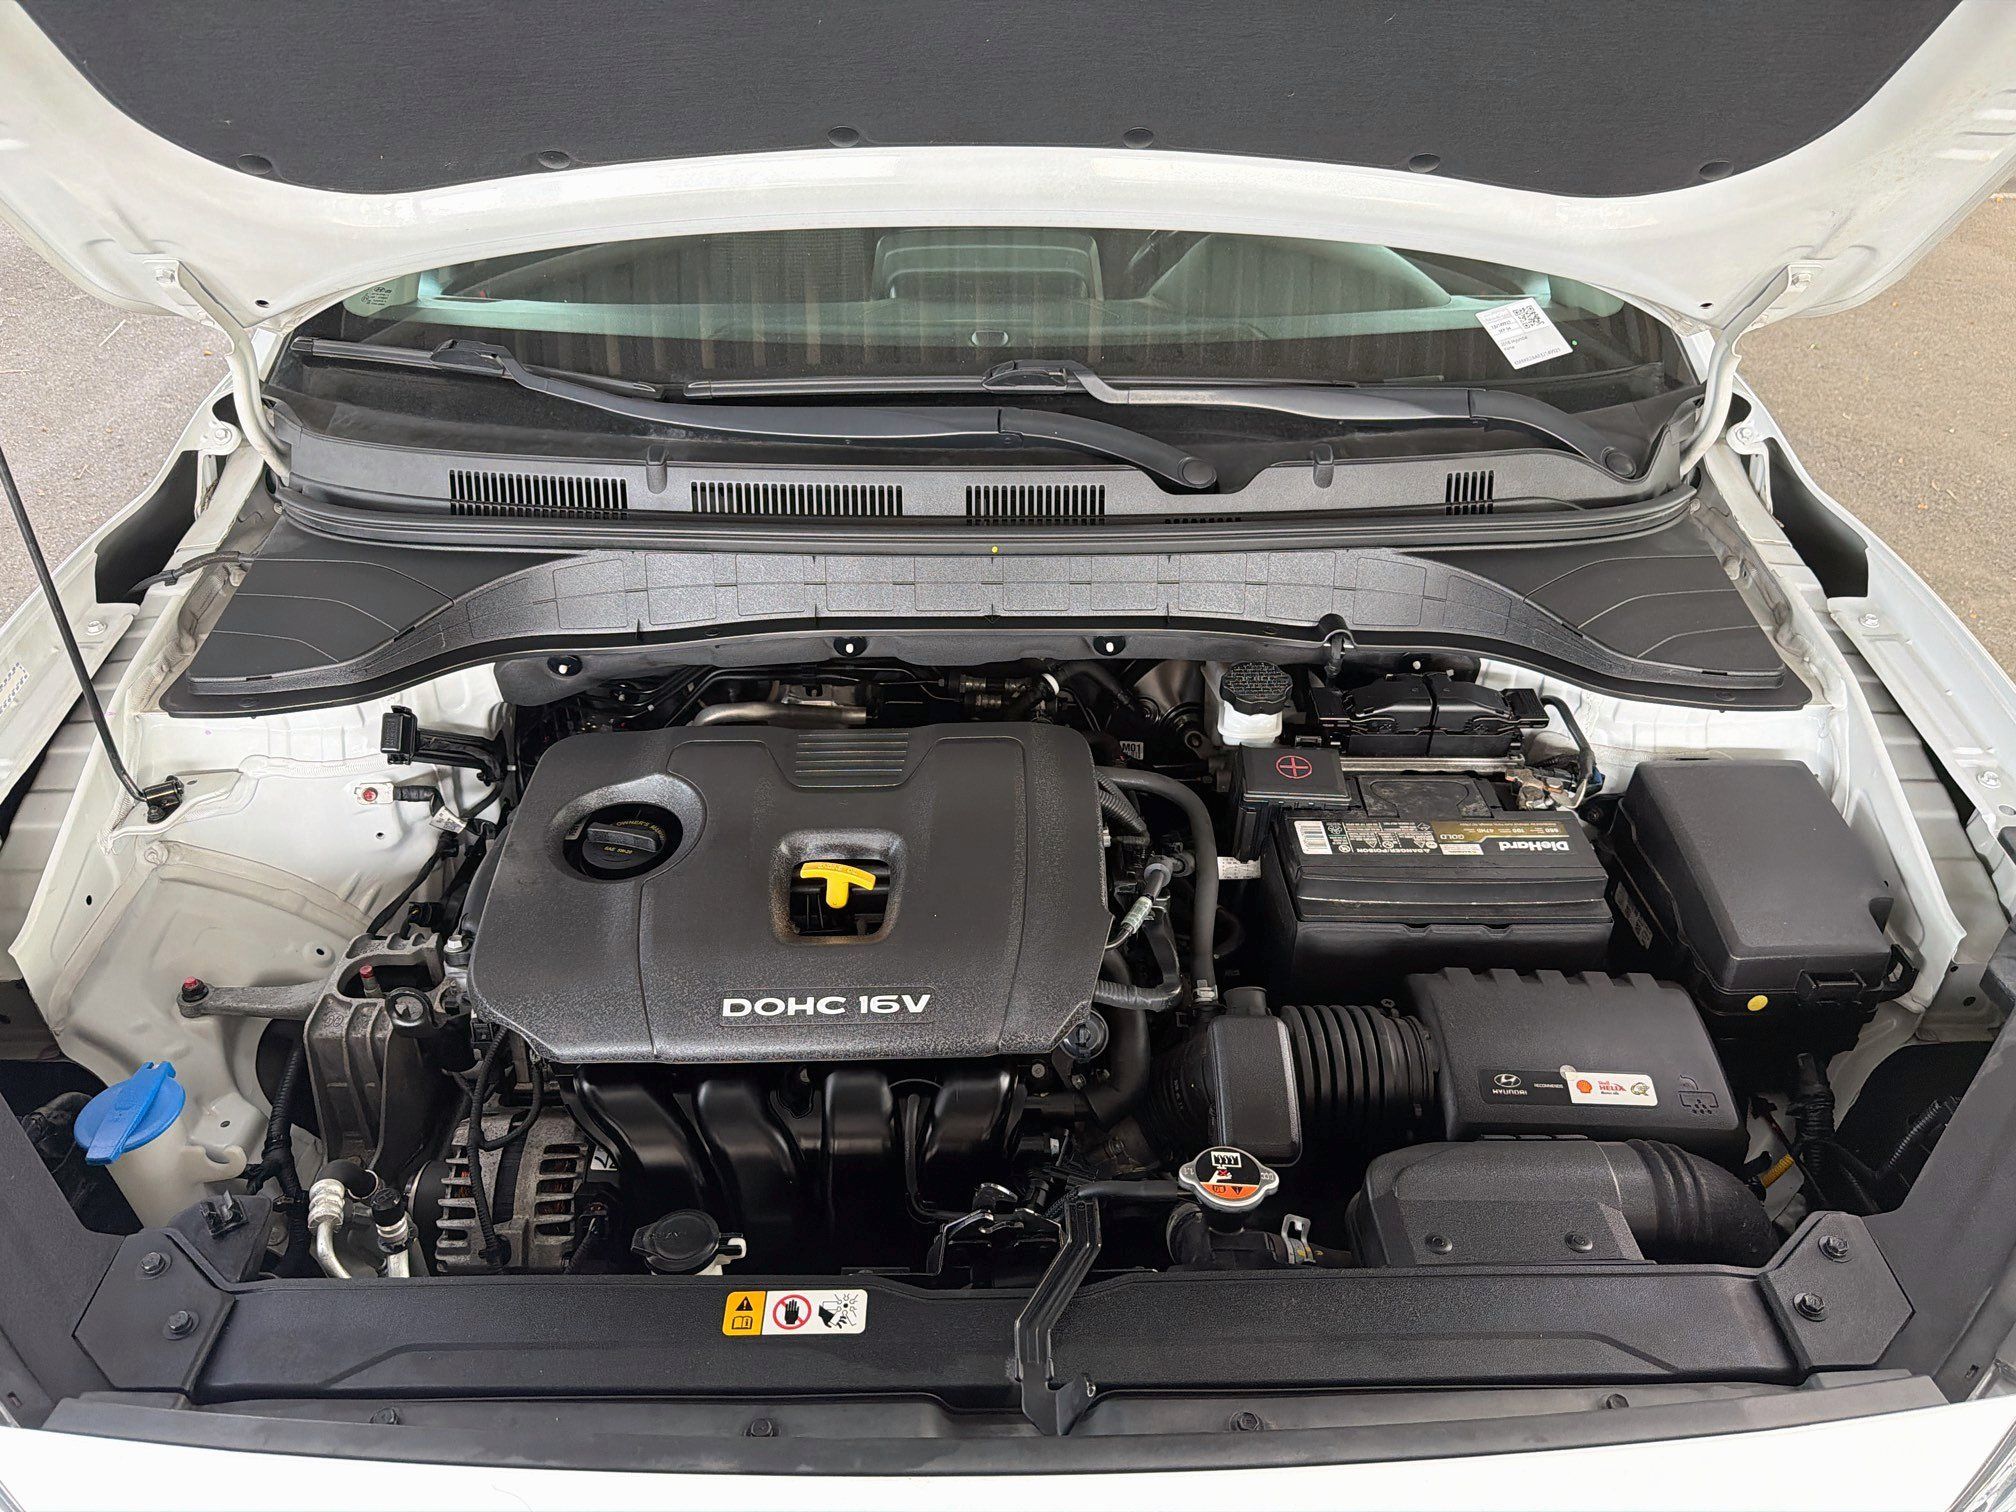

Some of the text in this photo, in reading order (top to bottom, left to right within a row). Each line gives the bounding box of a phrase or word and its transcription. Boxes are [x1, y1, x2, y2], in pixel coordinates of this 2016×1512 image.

[1122, 742, 1141, 752] M01
[1499, 841, 1570, 851] DieHard
[722, 994, 931, 1017] DOHC 16V
[1492, 1088, 1528, 1096] HYUNDAI
[1599, 1083, 1628, 1092] HELIX
